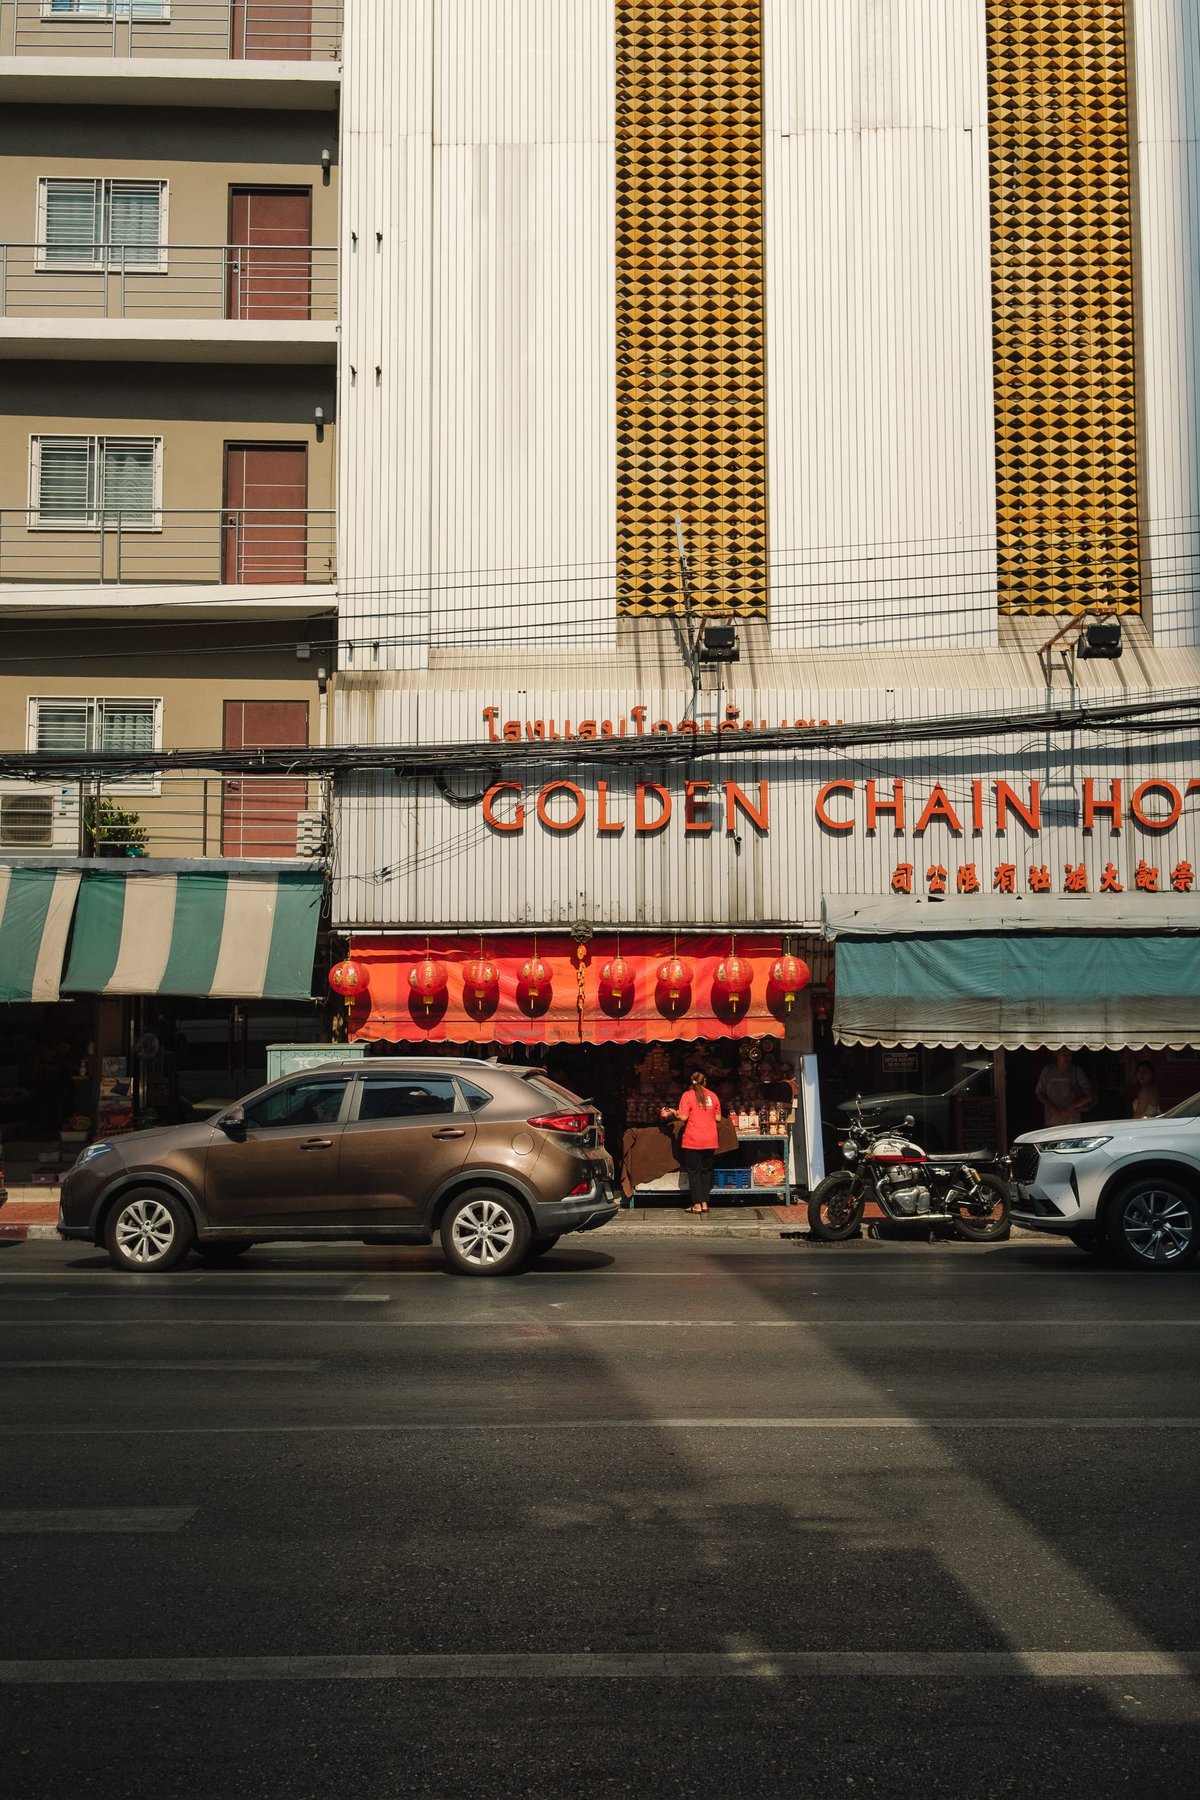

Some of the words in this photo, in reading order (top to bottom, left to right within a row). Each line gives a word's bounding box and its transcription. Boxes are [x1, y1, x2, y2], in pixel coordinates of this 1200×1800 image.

[482, 780, 769, 830] GOLDEN
[816, 779, 1041, 830] CHAIN
[1084, 778, 1200, 829] HO
